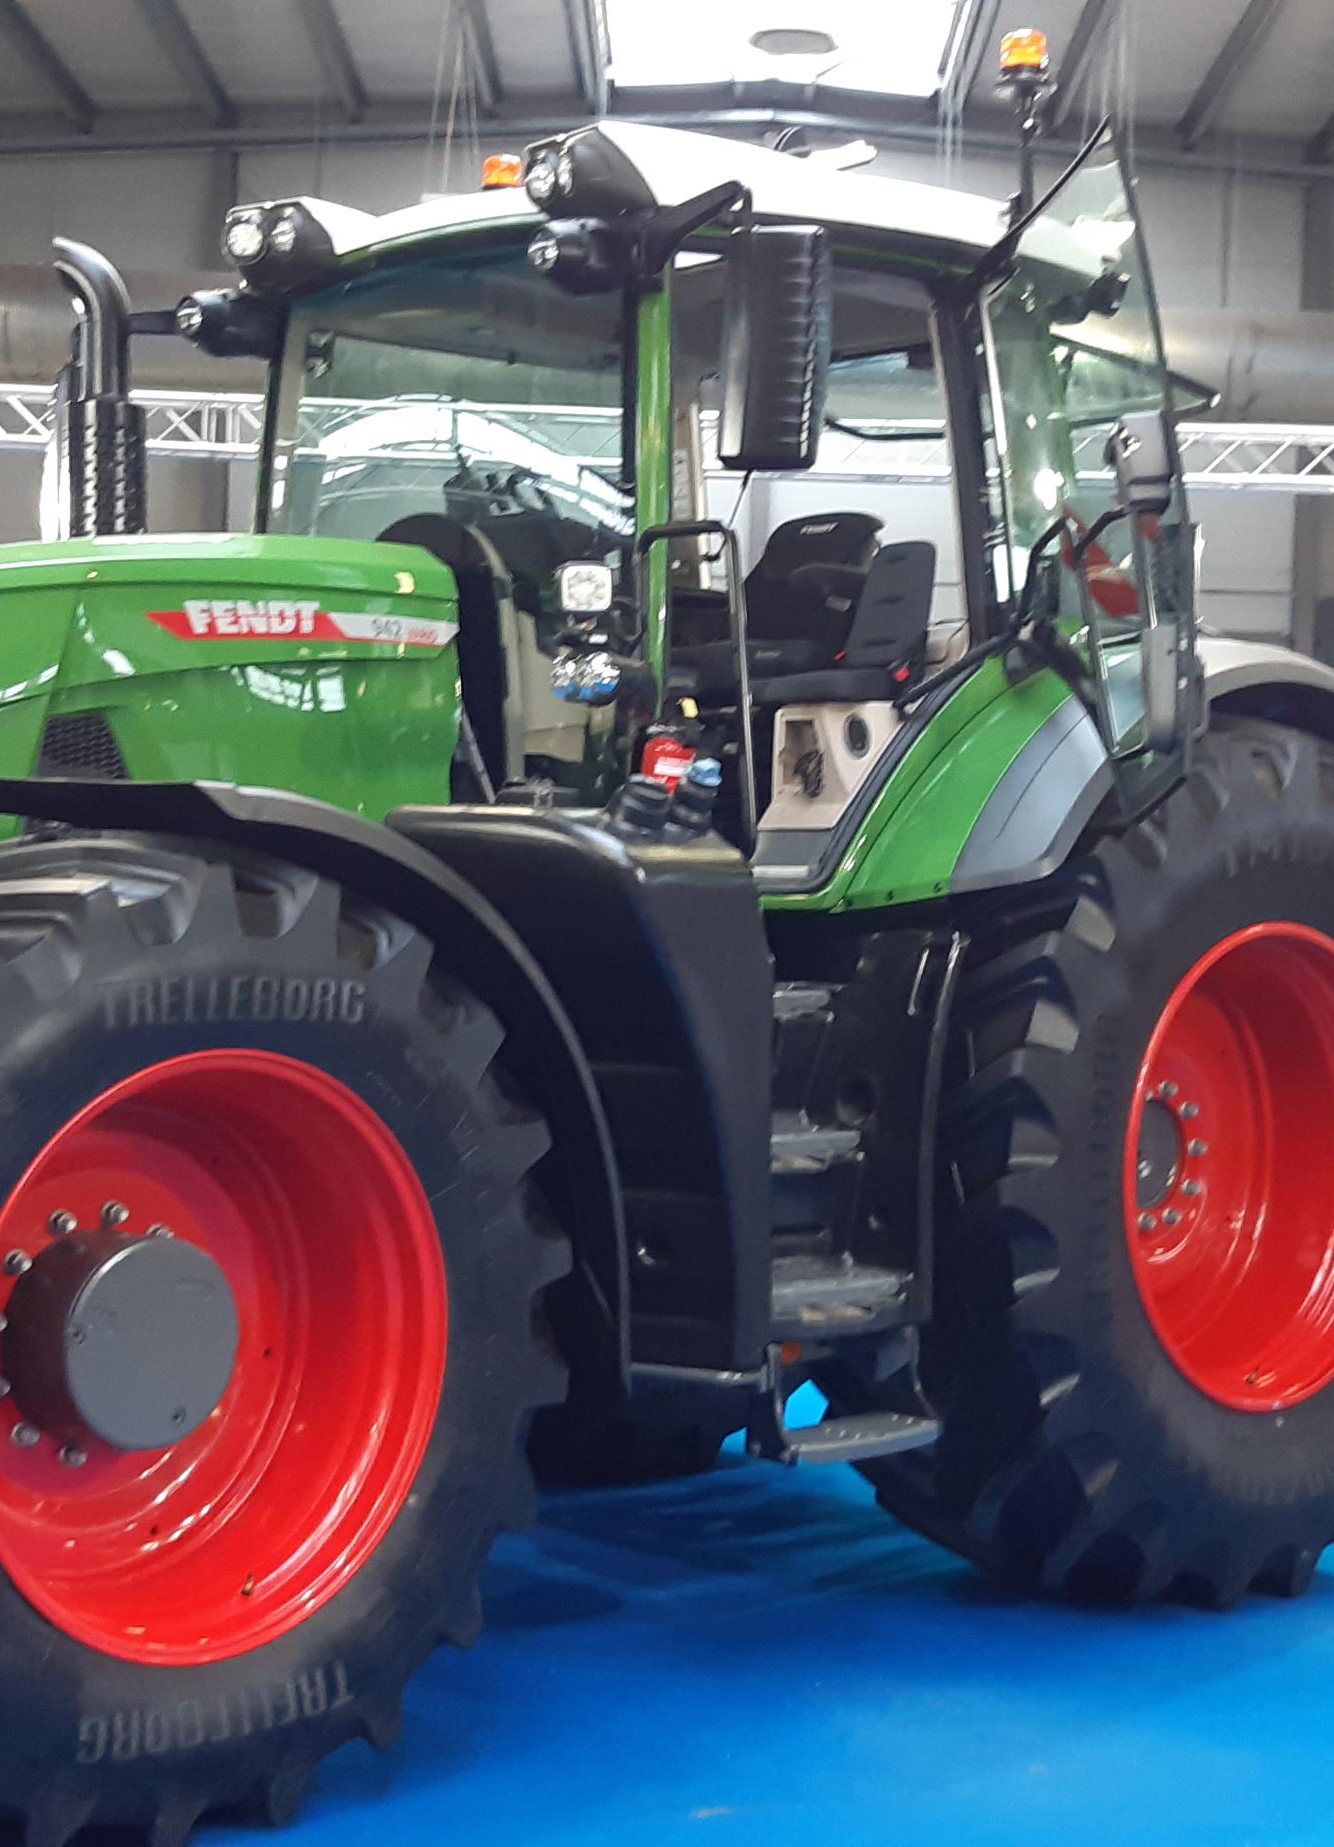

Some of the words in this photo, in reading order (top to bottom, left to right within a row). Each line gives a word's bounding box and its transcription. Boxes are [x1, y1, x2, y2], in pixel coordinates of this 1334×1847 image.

[182, 600, 320, 634] FENDT
[94, 970, 366, 1030] TRELLEBORG
[74, 1658, 356, 1764] TRELLEBORG
